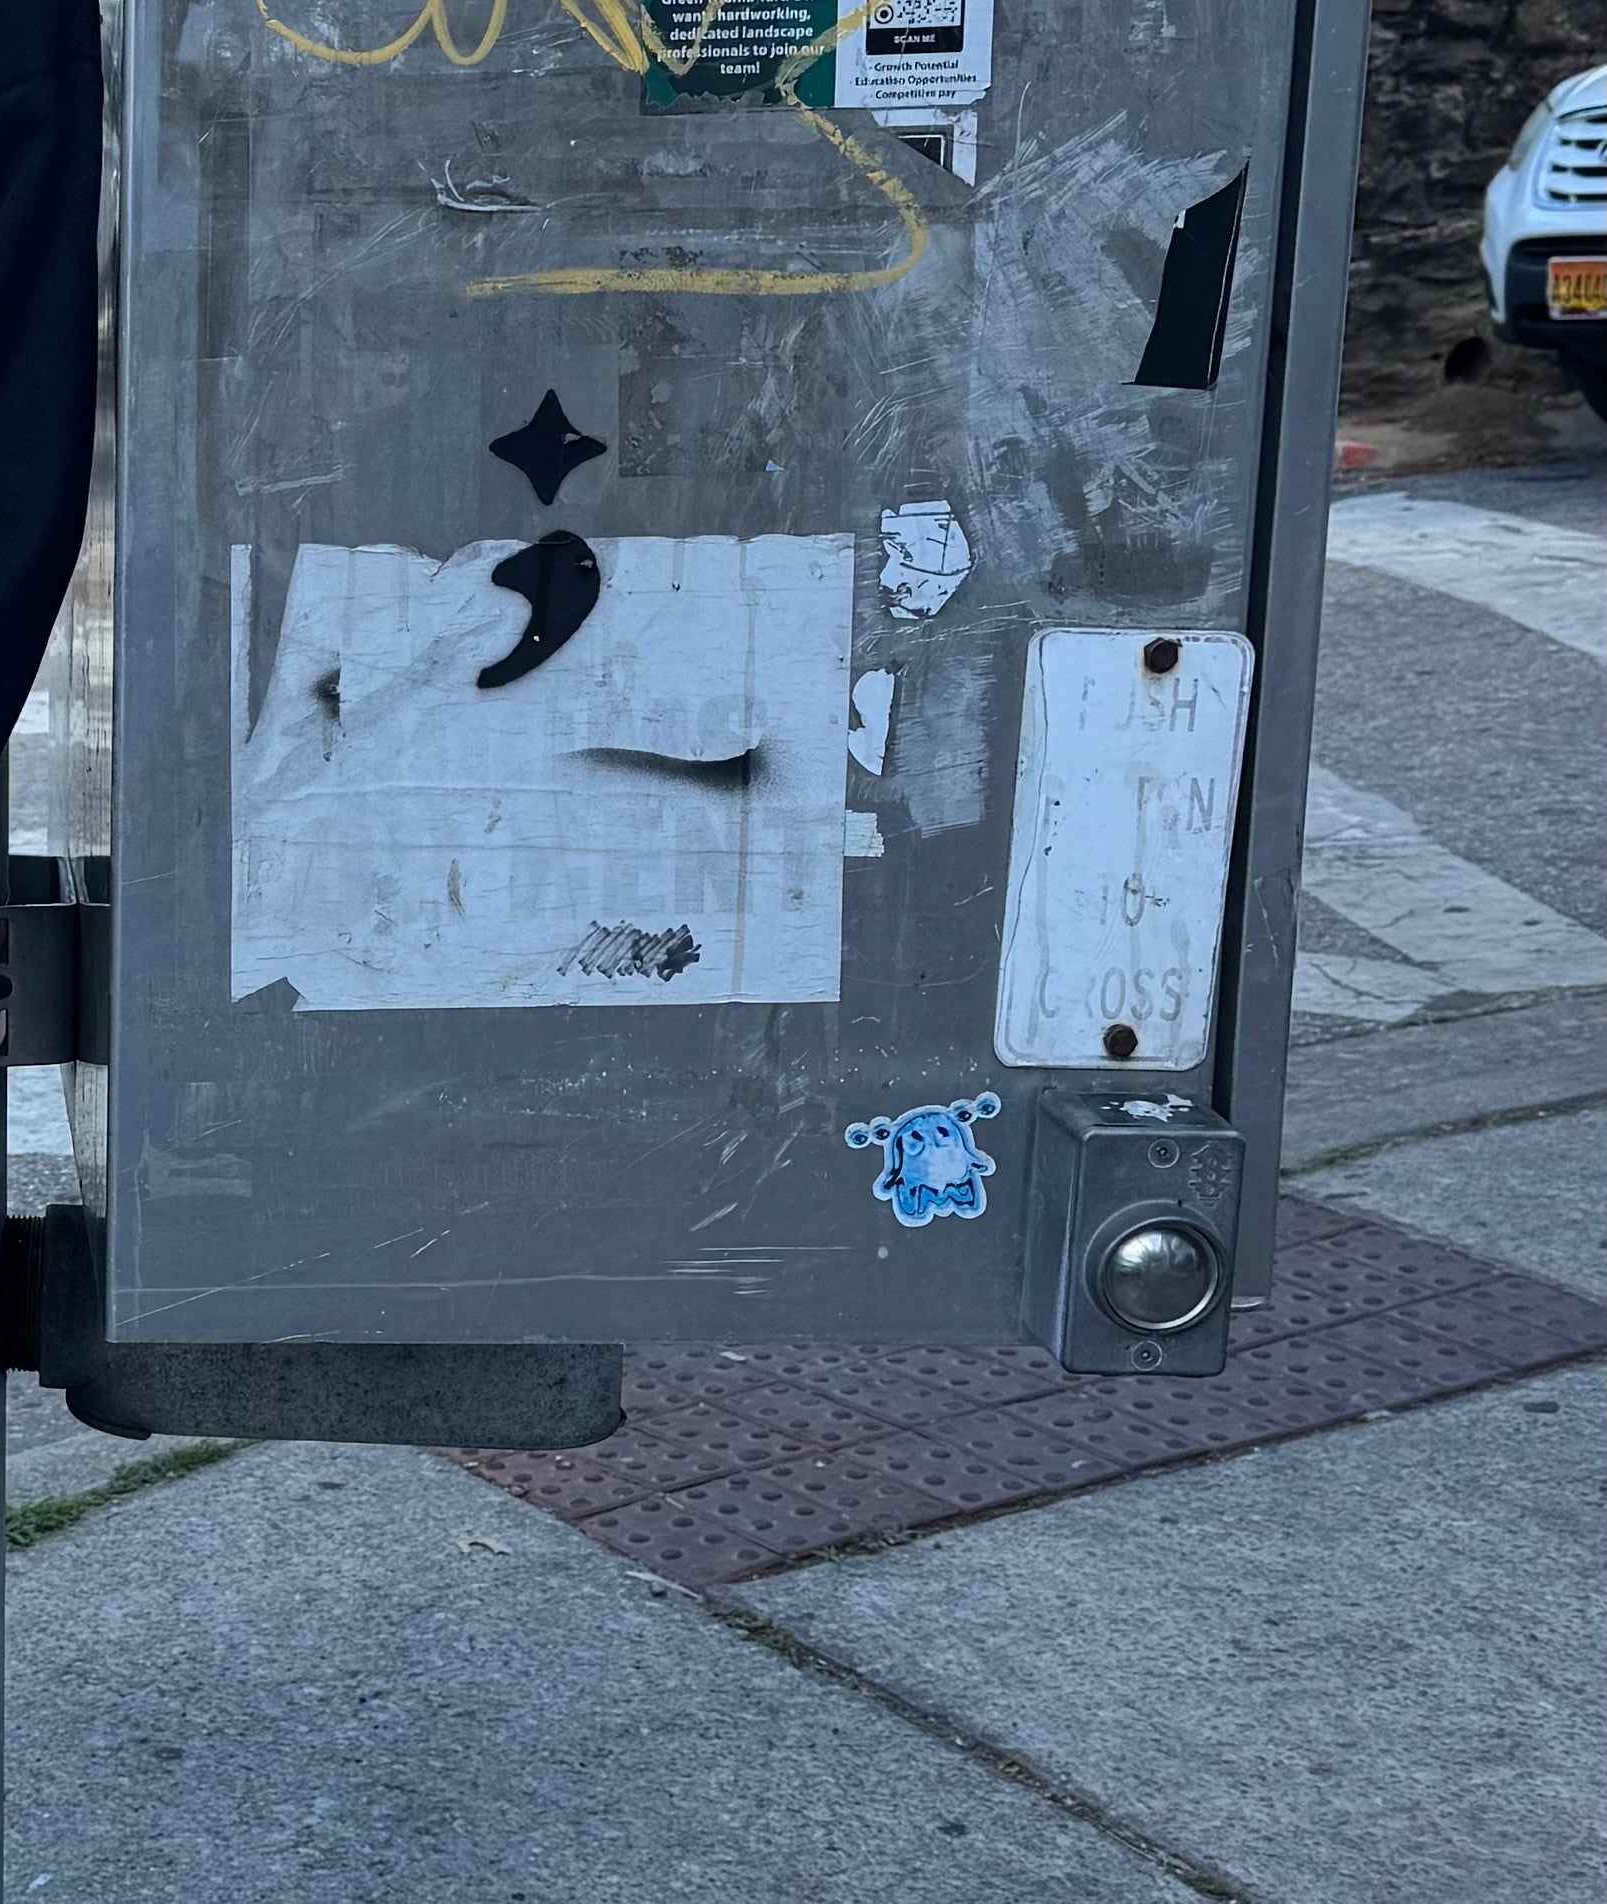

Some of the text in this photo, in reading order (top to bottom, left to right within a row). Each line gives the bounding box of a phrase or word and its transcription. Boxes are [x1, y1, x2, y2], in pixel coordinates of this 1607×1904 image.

[717, 6, 812, 23] hardworking,
[742, 24, 814, 41] landscape
[893, 34, 921, 44] SCAN
[752, 44, 768, 56] to
[769, 42, 798, 59] join
[719, 60, 761, 75] team!
[938, 89, 957, 99] pay
